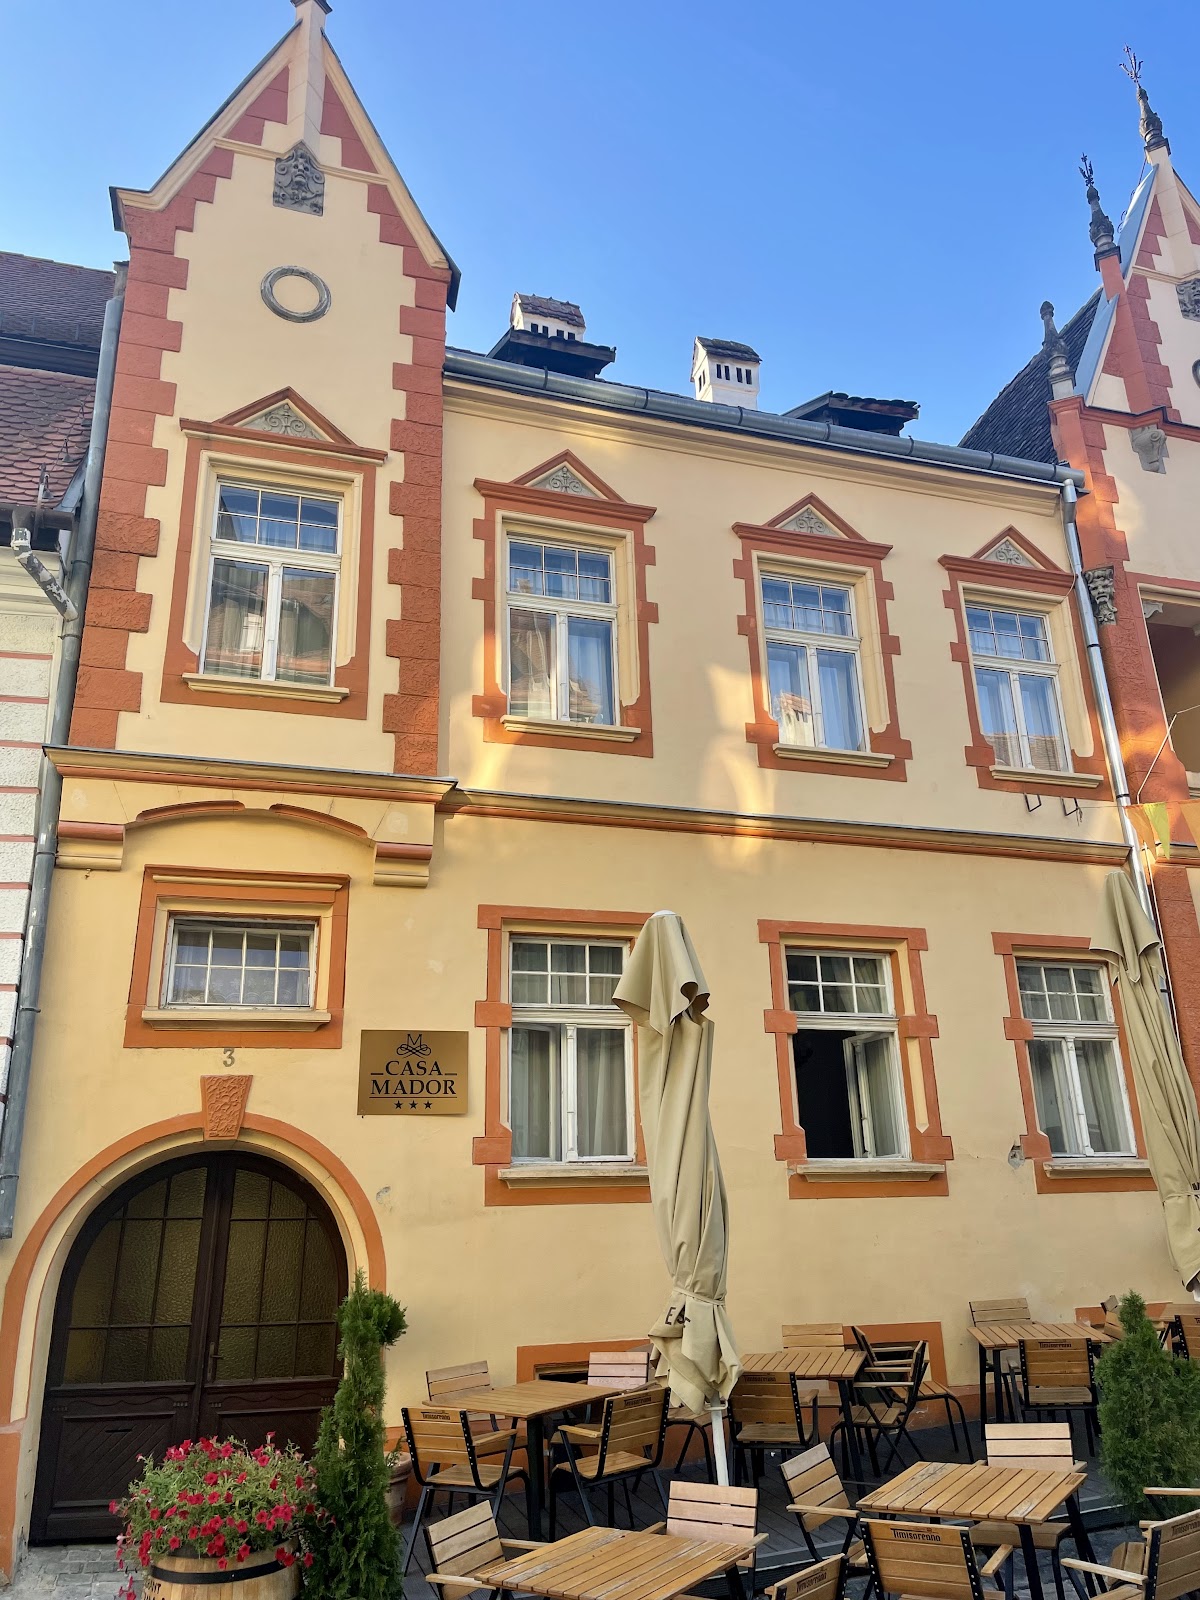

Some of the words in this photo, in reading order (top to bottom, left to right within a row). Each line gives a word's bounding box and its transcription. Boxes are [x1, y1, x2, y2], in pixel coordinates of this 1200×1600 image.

[222, 1047, 236, 1067] 3
[385, 1060, 443, 1076] CASA
[370, 1079, 457, 1095] MADOR
